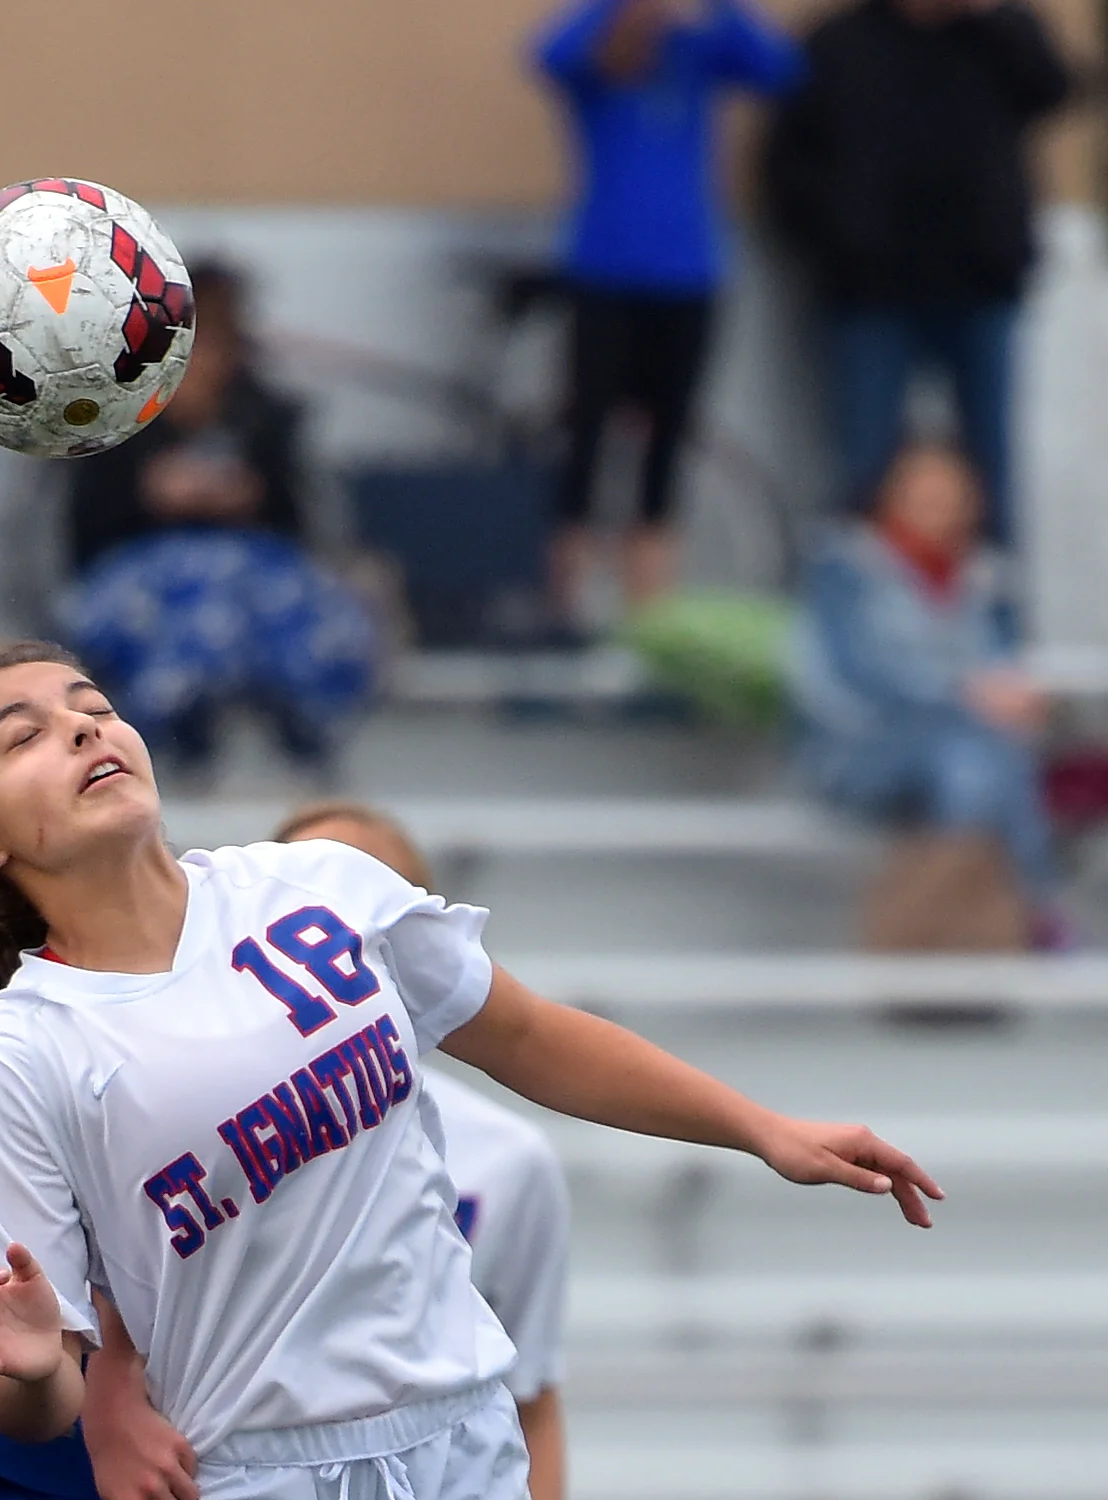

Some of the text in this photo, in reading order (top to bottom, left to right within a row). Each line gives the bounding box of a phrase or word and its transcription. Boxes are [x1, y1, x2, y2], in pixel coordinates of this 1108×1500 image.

[231, 904, 382, 1038] 18
[143, 1013, 413, 1260] ST. IGNATIUS
